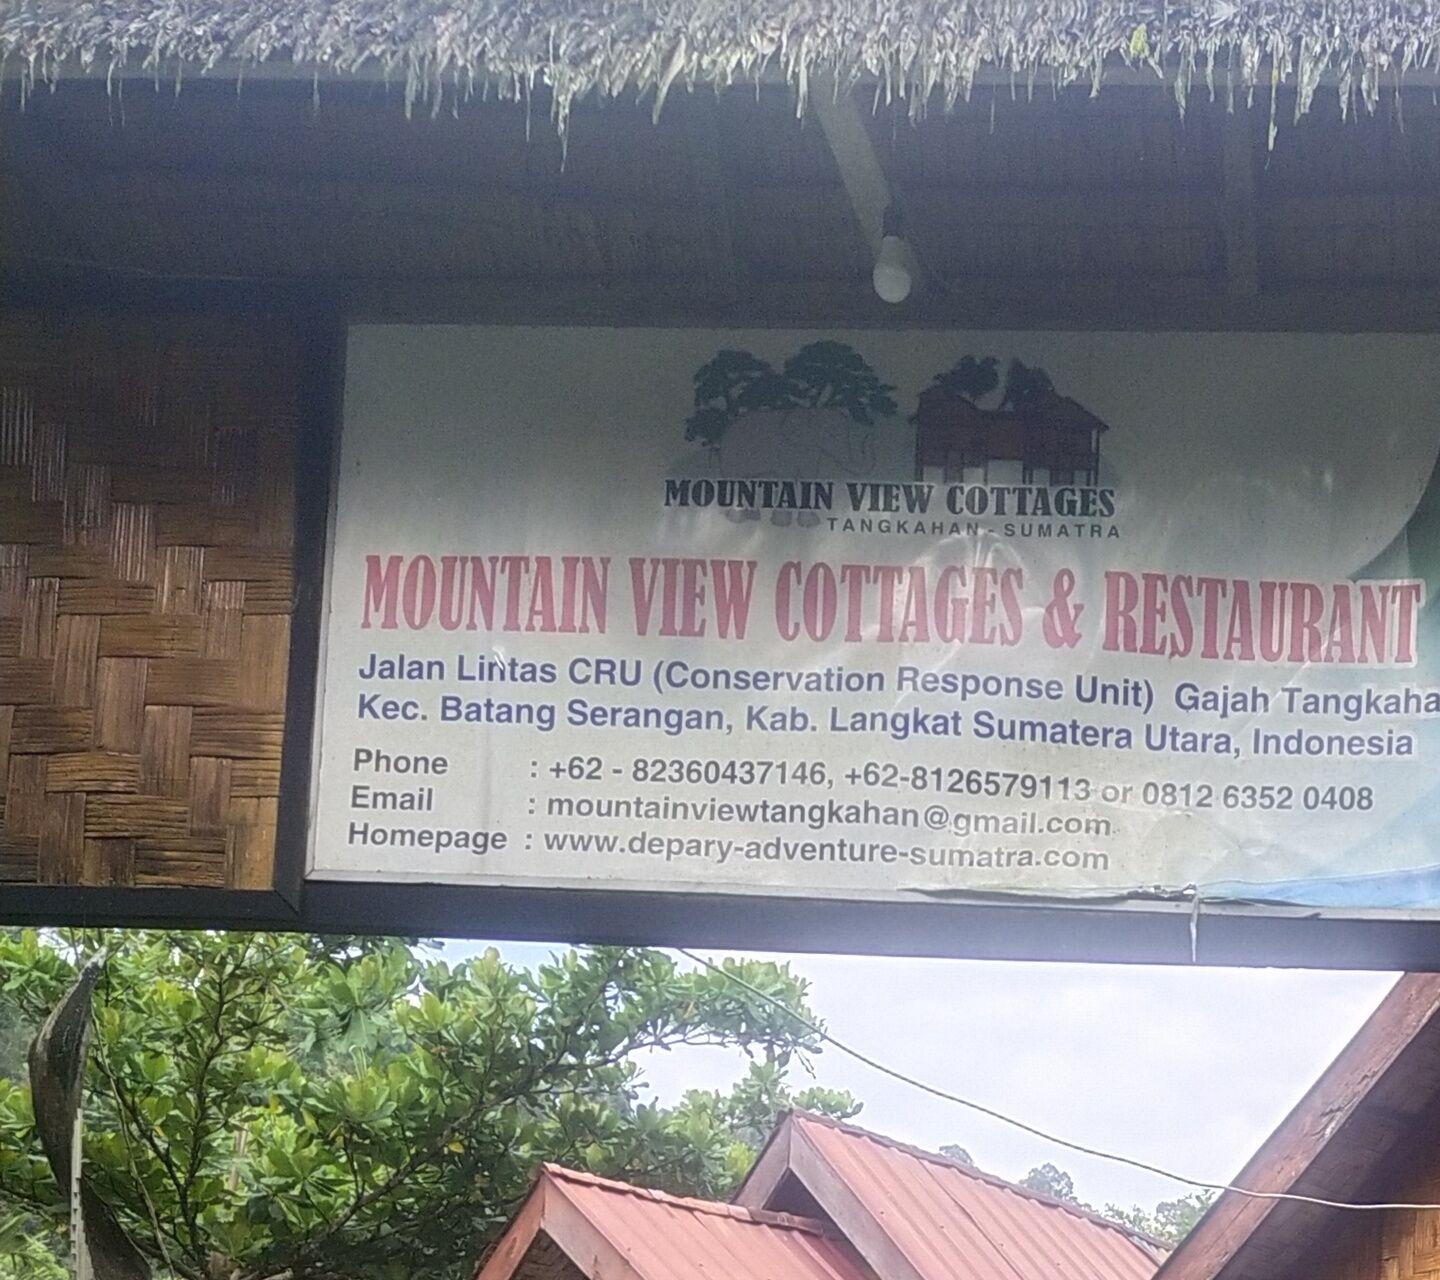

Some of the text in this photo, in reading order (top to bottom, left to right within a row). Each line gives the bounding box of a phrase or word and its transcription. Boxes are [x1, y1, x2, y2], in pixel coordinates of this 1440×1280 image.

[664, 479, 1115, 517] MOUNTAIN VIEW COTTAGES
[828, 517, 979, 536] TANGKAHAN
[1004, 523, 1120, 538] SUMATRA
[361, 554, 1421, 663] MOUNTAIN VIEW COTTAGES & RESTAURANT
[358, 653, 445, 681] Jalan
[457, 654, 557, 683] Lintas
[568, 657, 642, 686] CRU
[653, 660, 885, 694] (Conservation
[897, 666, 1063, 700] Response
[1075, 675, 1153, 714] Unit)
[1175, 683, 1269, 719] Gajah
[358, 693, 1413, 758] Kec. Batang Serangan, Kab. Langkat Sumatera Utara, Indonesia
[353, 748, 448, 775] Phone
[549, 756, 602, 780] +62
[632, 758, 834, 789] 82360437146,
[845, 762, 1091, 801] +62-8126579113
[1102, 782, 1133, 803] or
[1142, 782, 1213, 808] 0812
[1223, 785, 1292, 811] 6352
[1303, 786, 1374, 811] 0408
[350, 785, 433, 811] Email
[547, 796, 1111, 837] mountainviewtangkahan@gmail.com
[348, 822, 508, 855] Homepage
[544, 831, 1109, 870] www.depary-adventure-sumatra.com
